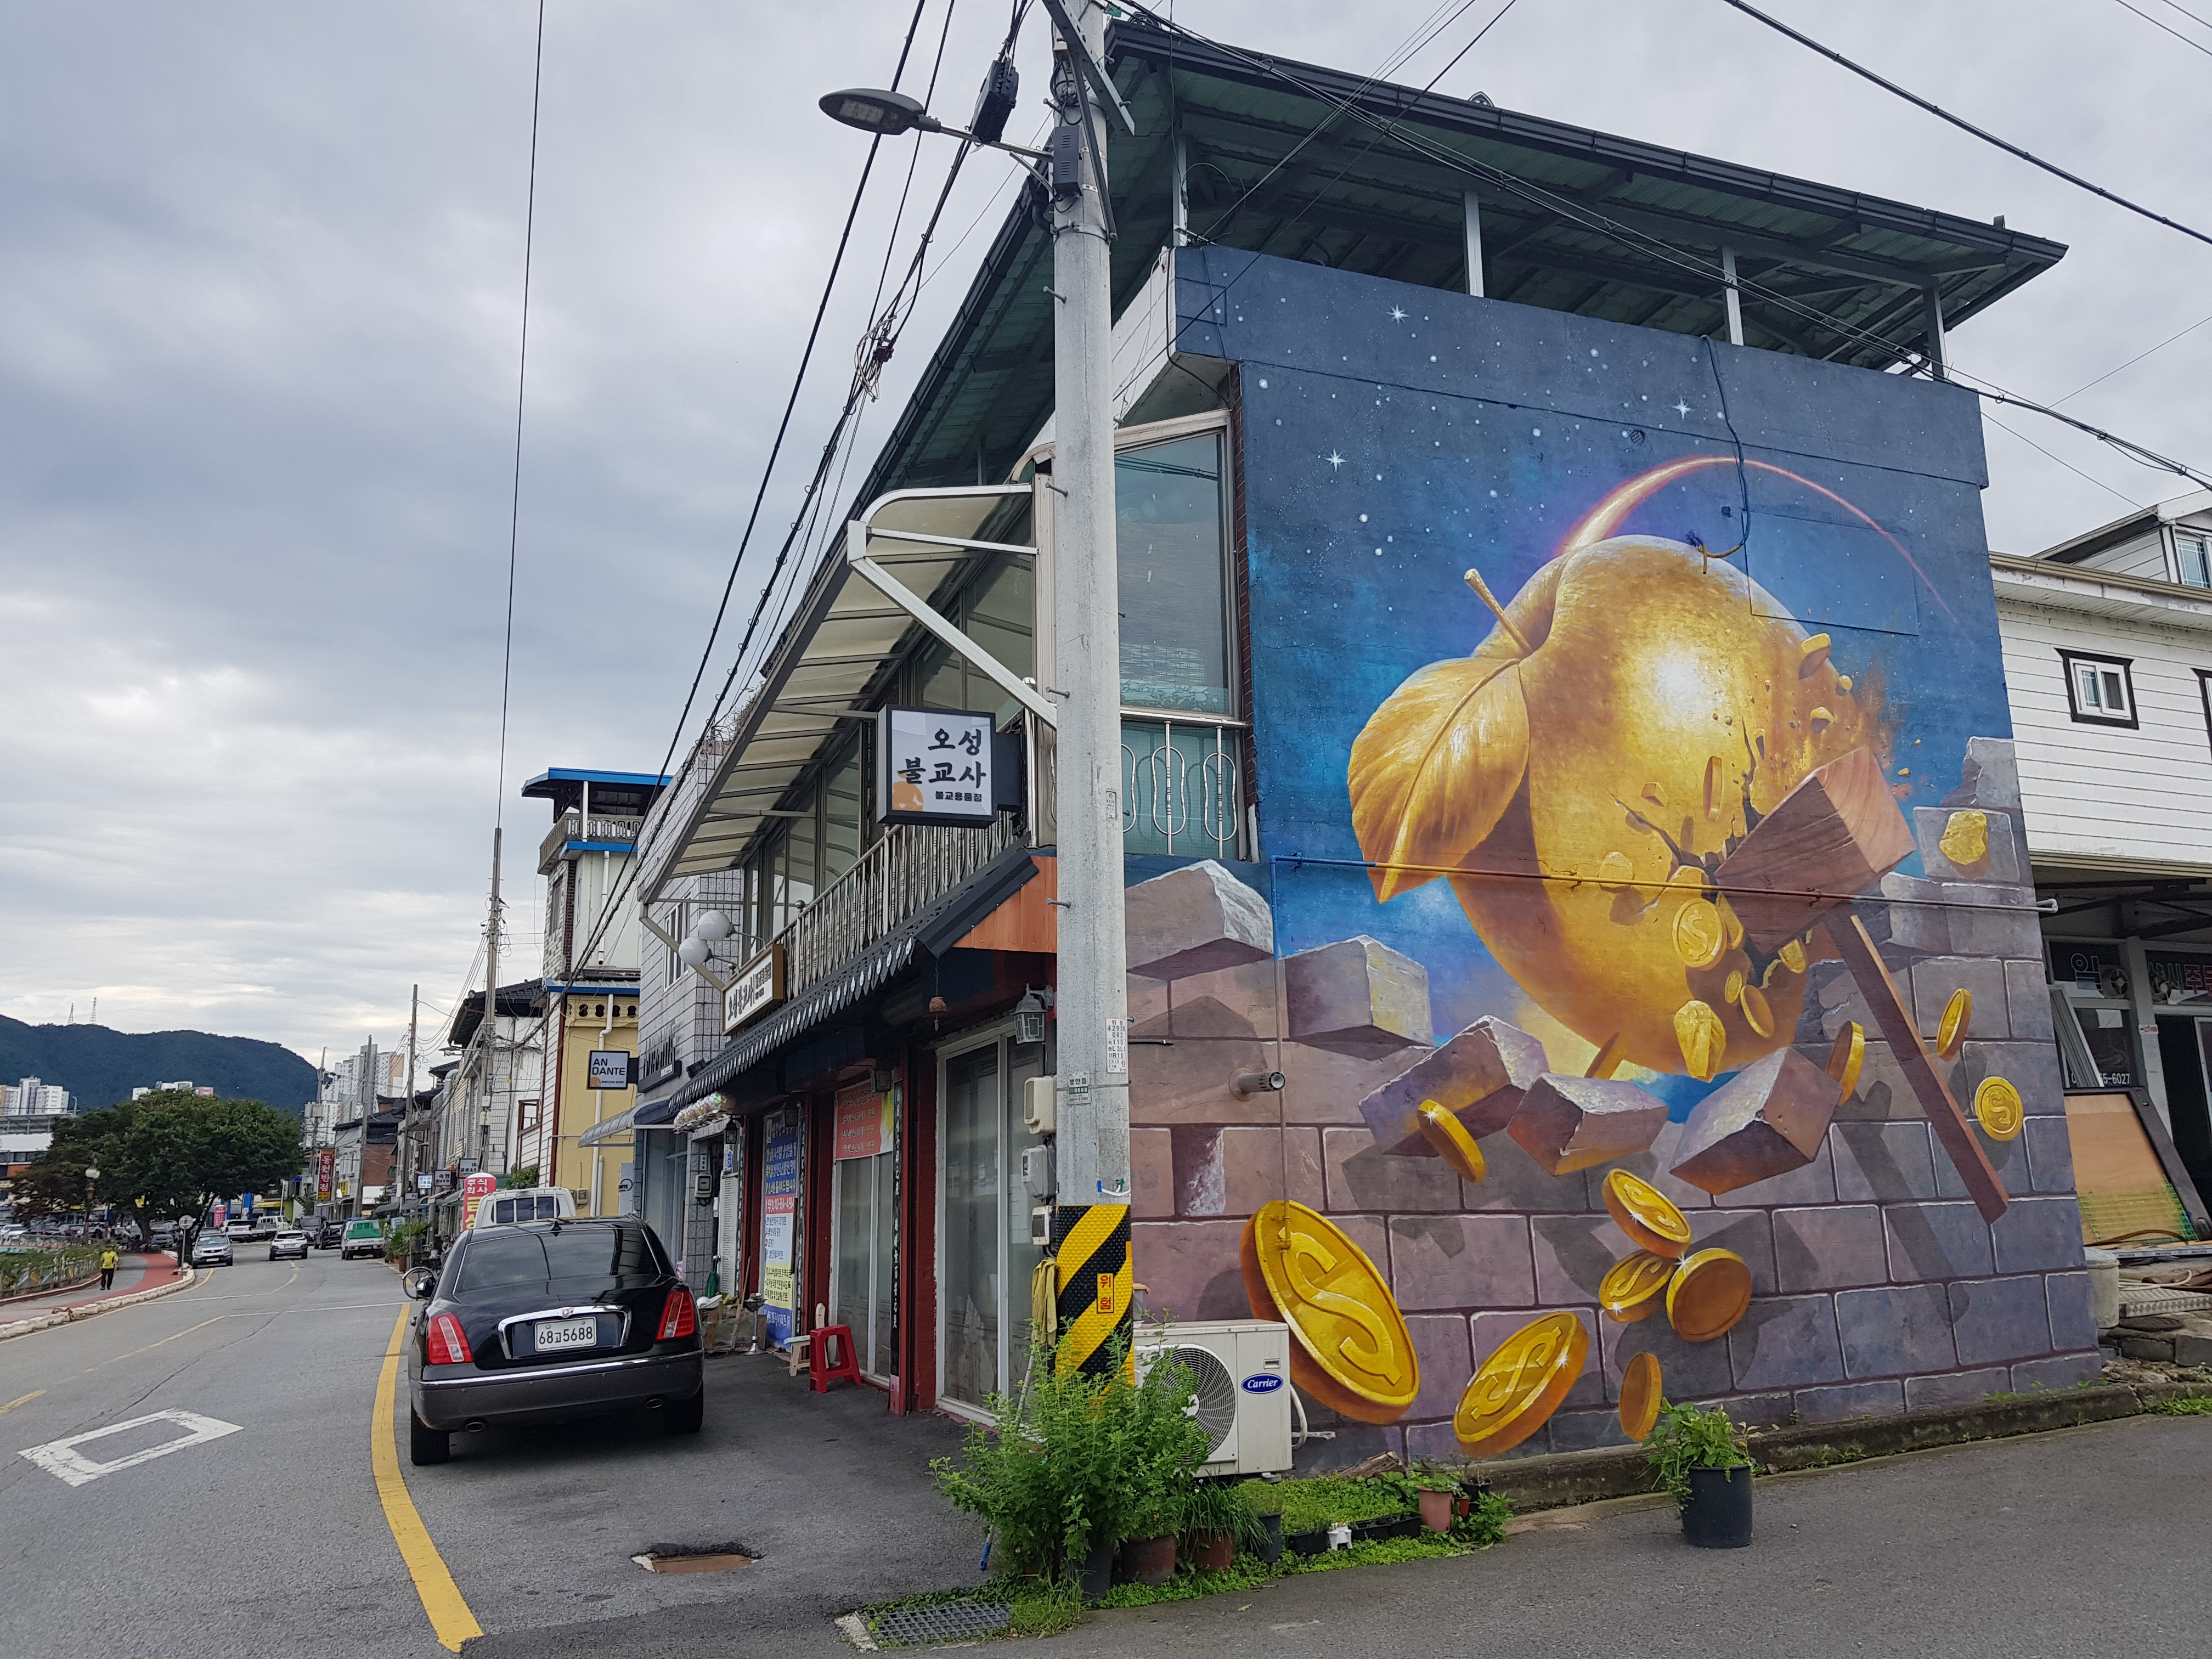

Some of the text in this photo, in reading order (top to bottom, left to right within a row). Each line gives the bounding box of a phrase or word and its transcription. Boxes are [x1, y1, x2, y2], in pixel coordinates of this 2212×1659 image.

[928, 728, 982, 755] 오성
[898, 757, 986, 788] 불교사
[935, 791, 982, 802] 불교용품점
[728, 977, 753, 1021] 오성불교사
[592, 1067, 625, 1075] DANTE
[319, 1155, 331, 1192] 동원반점
[466, 1186, 488, 1194] 회사
[467, 1178, 488, 1187] 주식
[539, 1326, 593, 1345] 68고5688
[1247, 1378, 1278, 1389] Carrier
